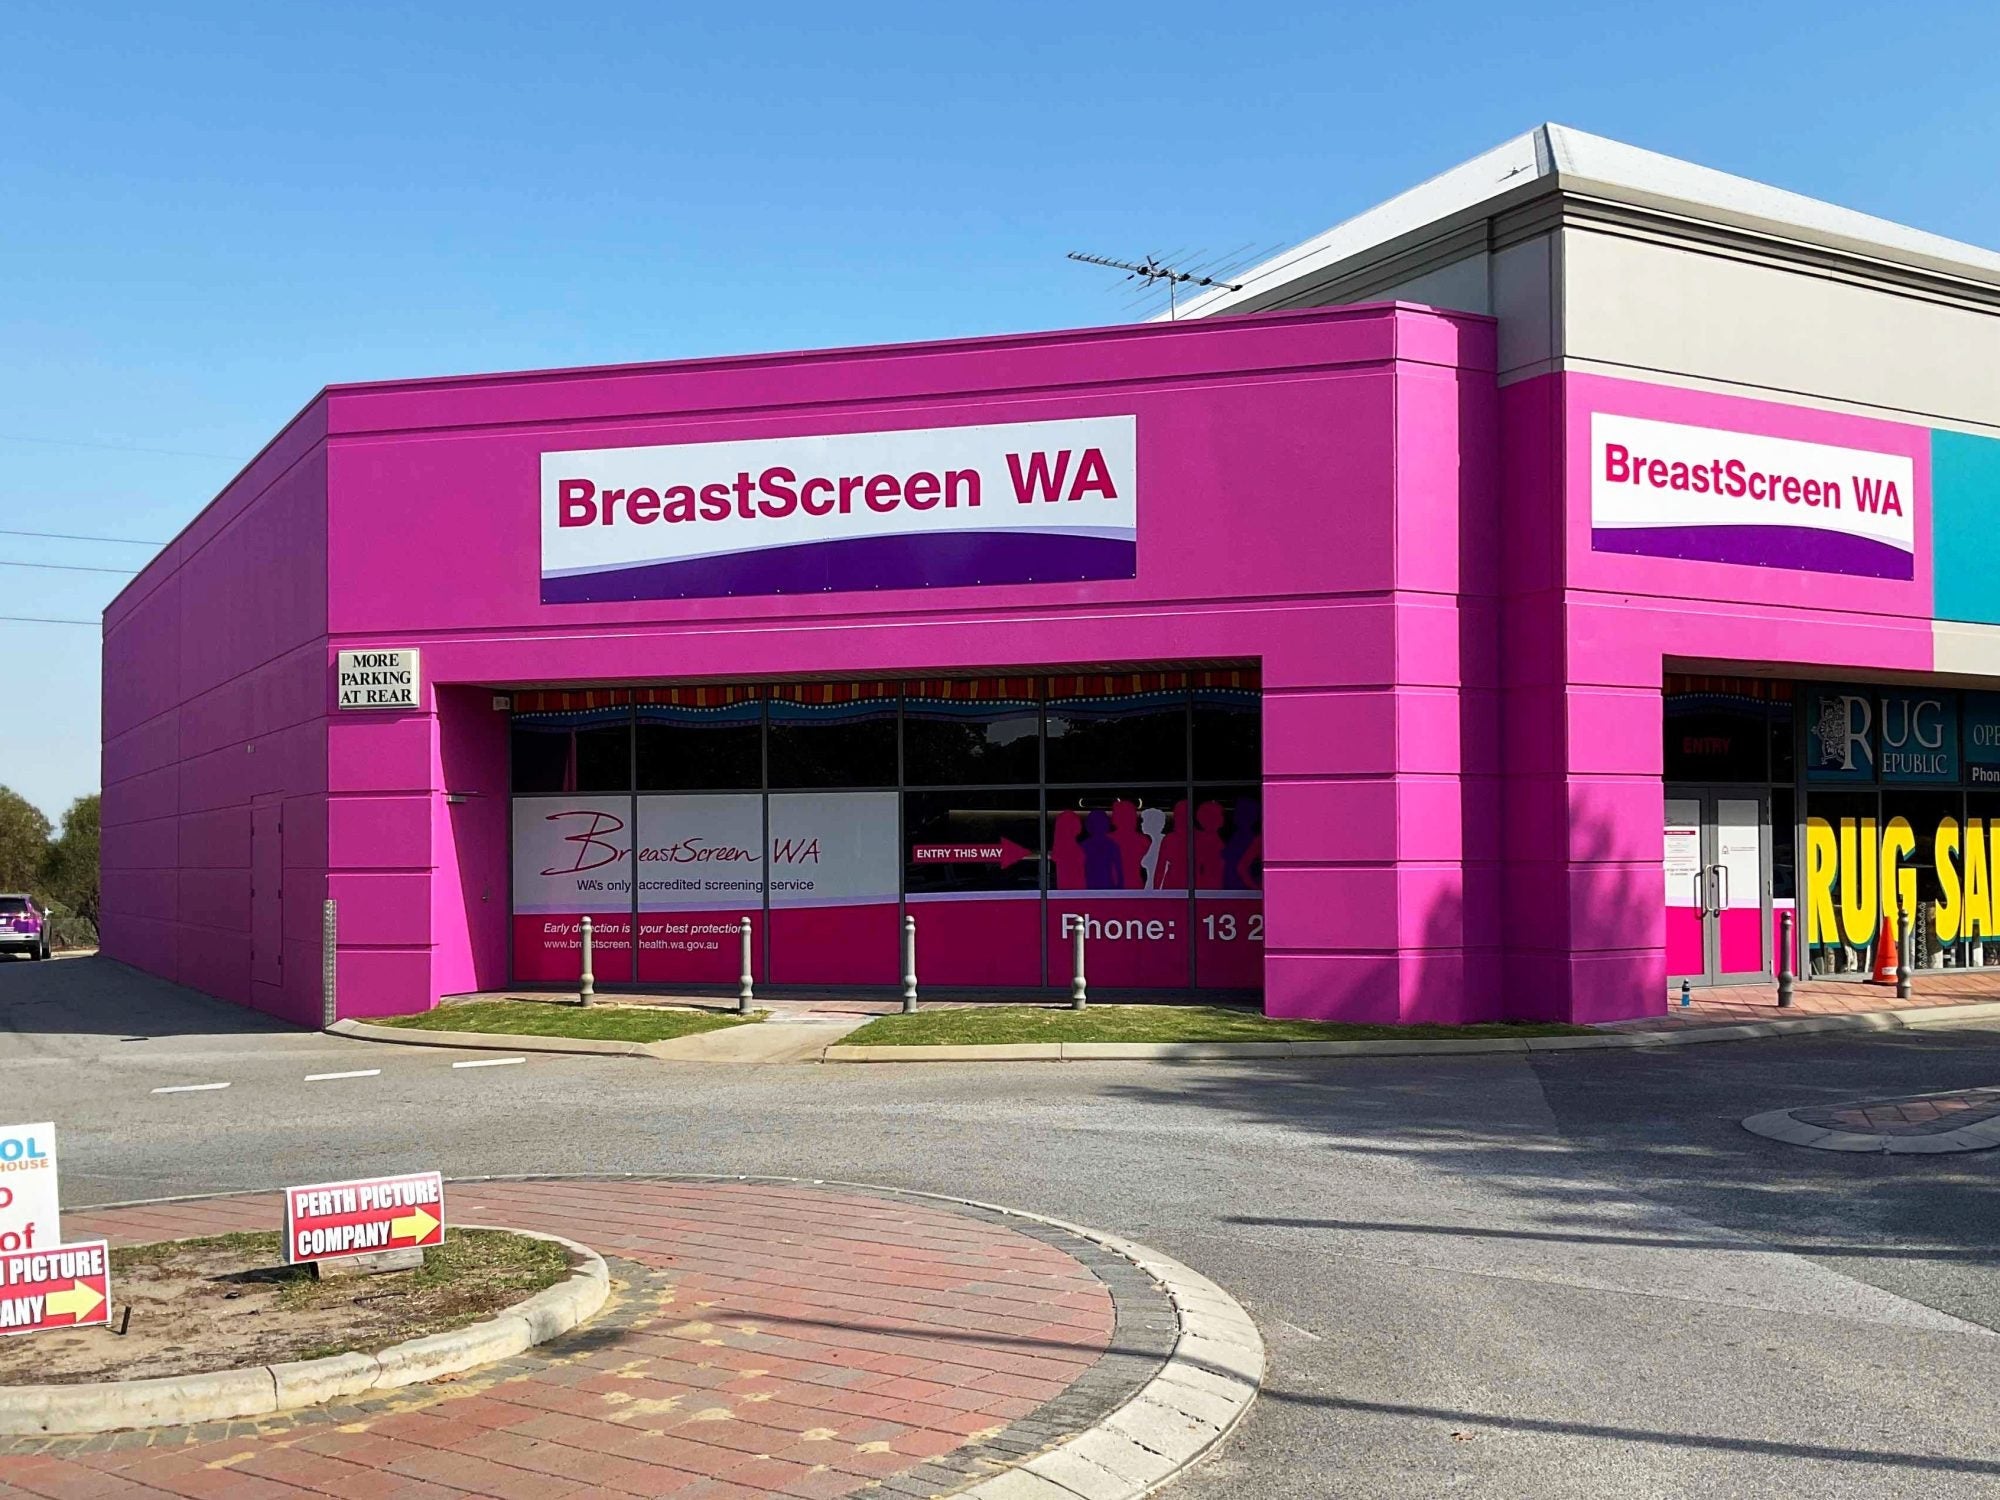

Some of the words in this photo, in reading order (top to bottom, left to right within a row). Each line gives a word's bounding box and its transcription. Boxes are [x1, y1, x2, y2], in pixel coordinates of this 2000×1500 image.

[558, 465, 982, 528] BreastScreen
[1005, 447, 1118, 504] WA
[1605, 443, 1841, 510] BreastScreen
[1852, 476, 1903, 517] WA
[353, 653, 399, 668] MORE
[341, 671, 411, 686] PARKING
[340, 690, 361, 704] AT
[367, 688, 412, 703] REAR
[1682, 737, 1730, 755] ENTRY
[540, 810, 762, 876] BreastScreen
[773, 838, 821, 864] WA
[917, 849, 951, 859] ENTRY
[953, 848, 978, 858] THIS
[980, 848, 1003, 858] WAY
[576, 880, 603, 891] WA's
[607, 880, 632, 893] only
[638, 879, 701, 890] accredited
[705, 879, 764, 893] screening
[770, 879, 815, 890] service
[1806, 816, 1918, 947] RUG
[543, 922, 570, 936] Early
[571, 922, 619, 933] dction
[621, 922, 631, 933] is
[639, 925, 663, 936] your
[665, 923, 688, 934] best
[1061, 913, 1176, 940] Phone:
[1202, 914, 1237, 941] 13
[296, 1188, 357, 1219] PERTH
[360, 1179, 439, 1211] PICTURE
[298, 1221, 391, 1256] COMPANY
[9, 1250, 104, 1285] PICTURE
